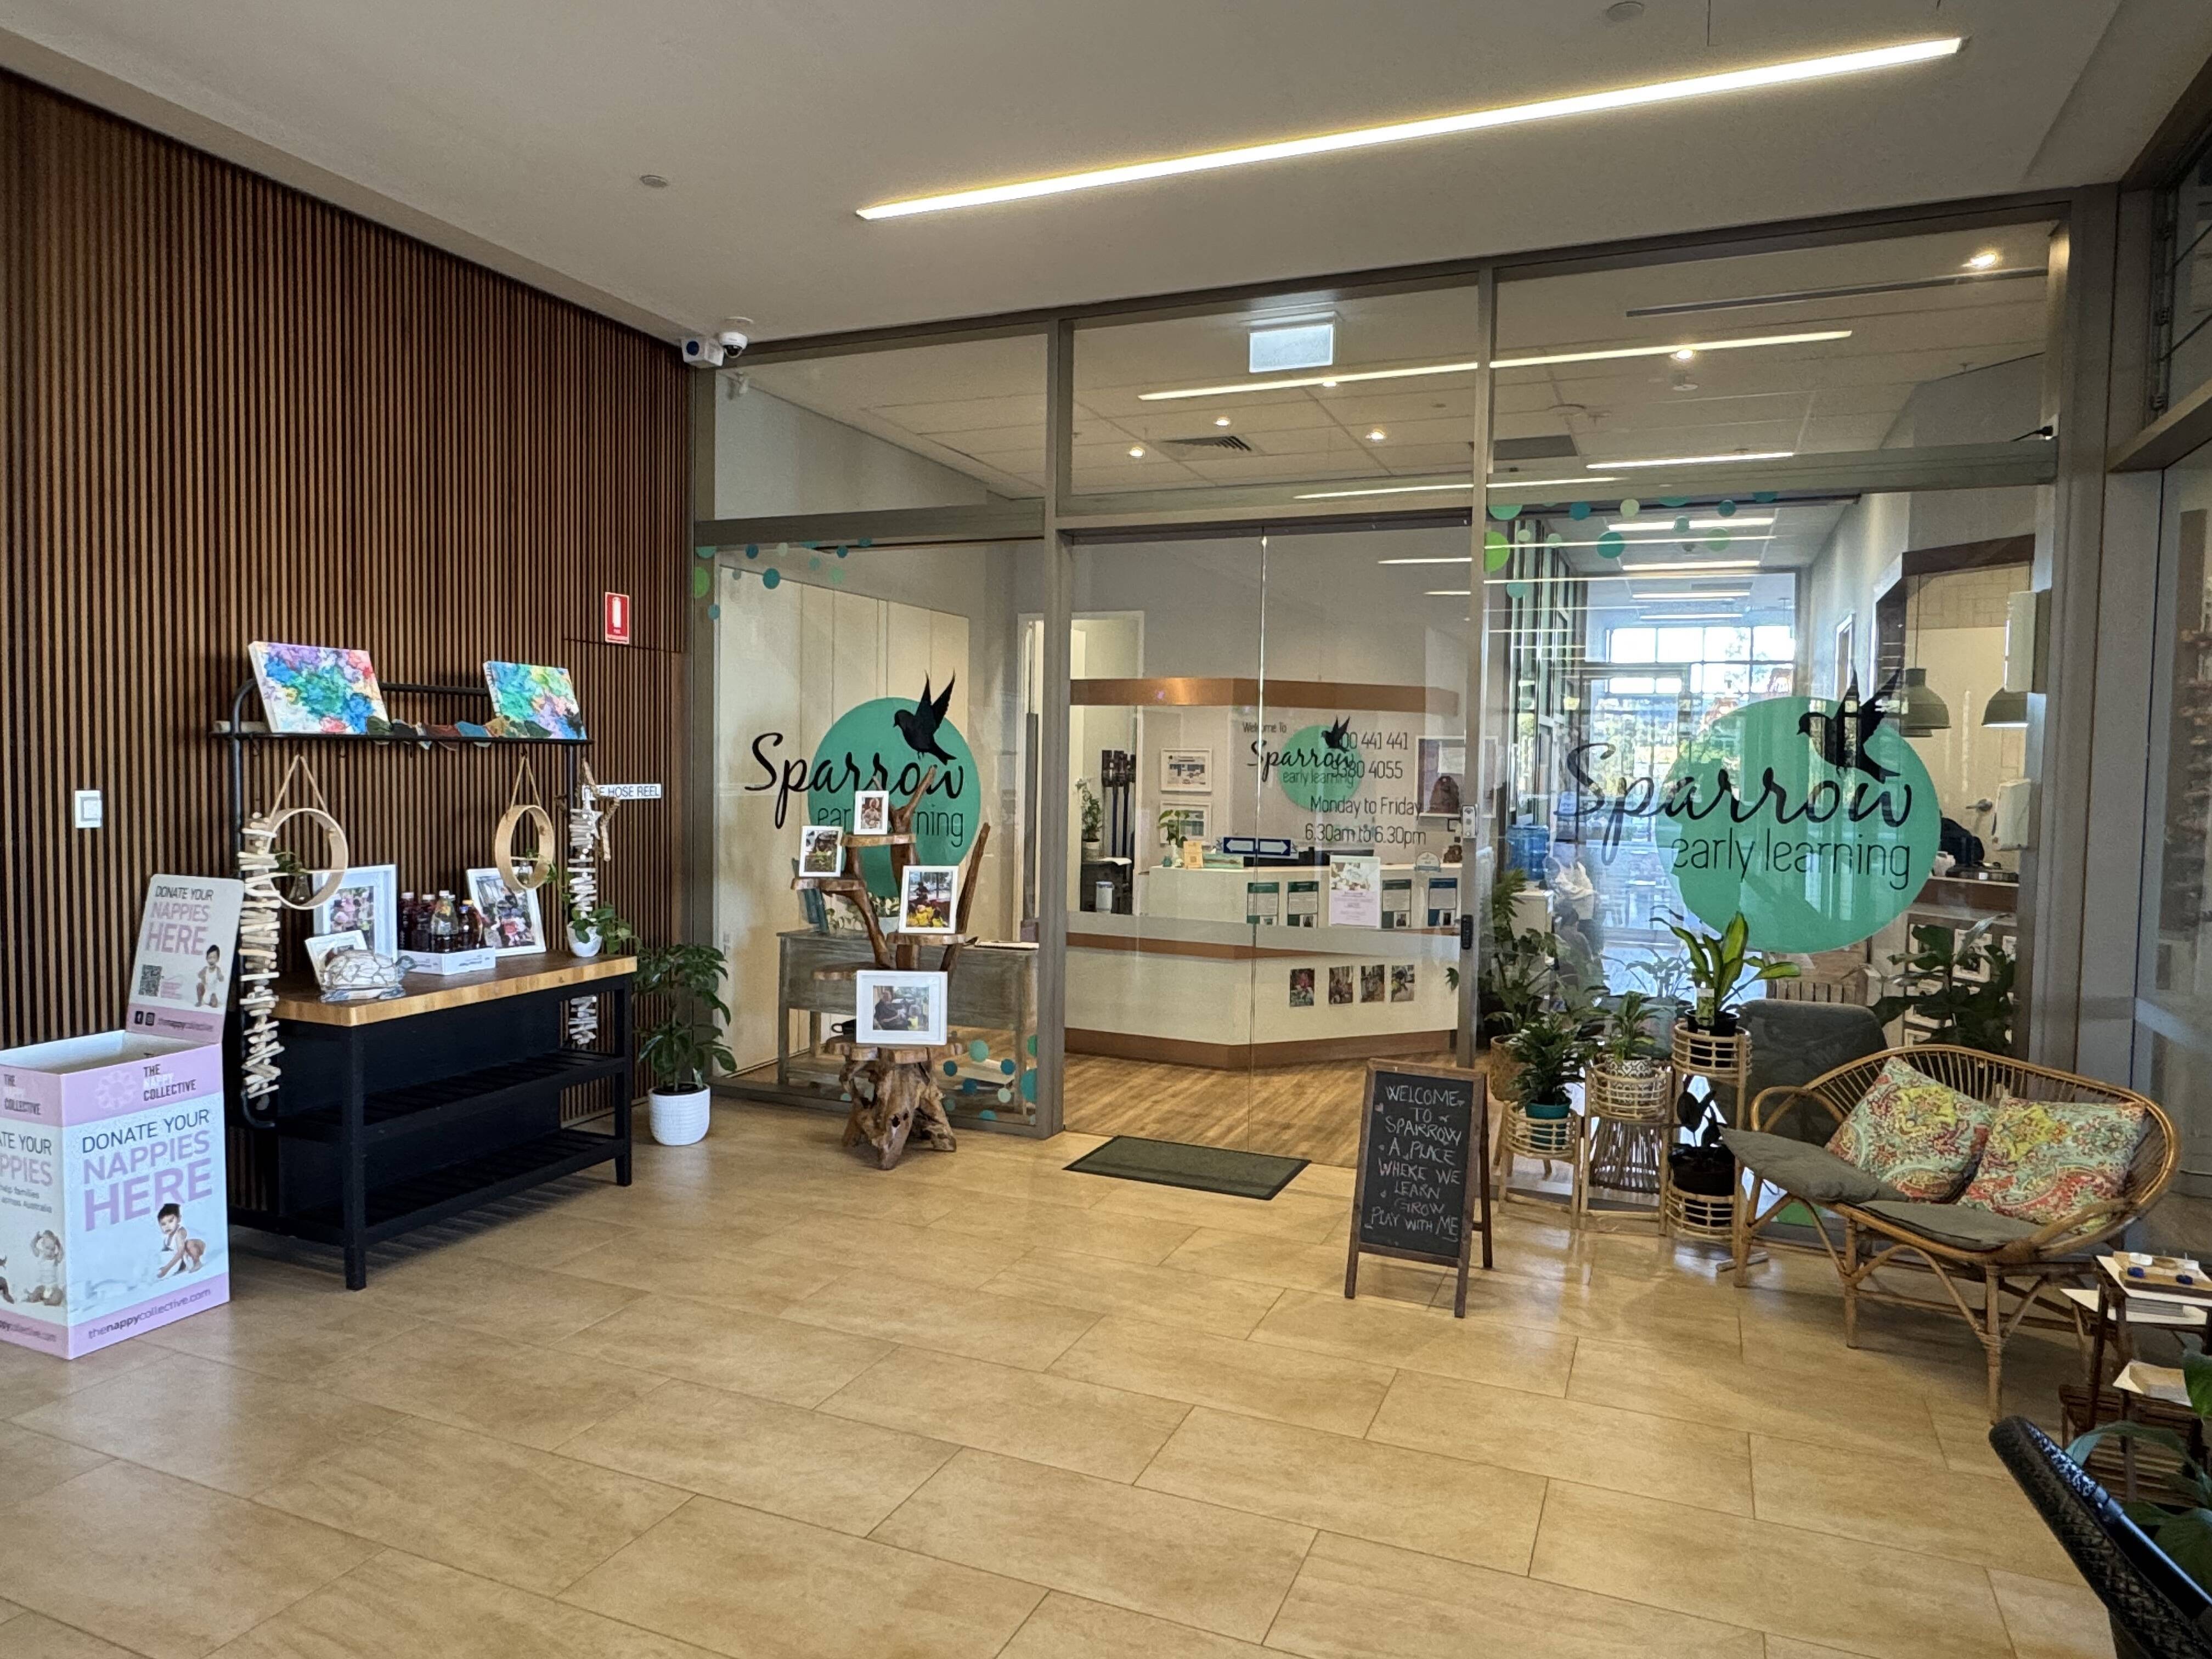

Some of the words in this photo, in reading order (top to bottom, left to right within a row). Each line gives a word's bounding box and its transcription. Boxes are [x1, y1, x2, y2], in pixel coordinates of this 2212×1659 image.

[1279, 722, 1287, 733] To
[1361, 731, 1382, 750] 441
[1386, 731, 1408, 751] 441
[1247, 740, 1353, 782] Sparrow
[1369, 760, 1403, 779] 4055
[744, 732, 964, 830] Sparrow
[1283, 769, 1308, 787] early
[608, 786, 634, 798] HOSE
[637, 786, 660, 797] REEL
[1553, 742, 1913, 866] Sparrow
[1310, 795, 1361, 819] Monday
[1364, 798, 1377, 815] to
[1380, 797, 1422, 821] Friday
[1305, 823, 1356, 842] 6.30am
[1358, 825, 1372, 843] to
[1374, 825, 1426, 849] 6.30pm
[1672, 827, 1755, 884] early
[1765, 828, 1910, 890] learning
[155, 885, 189, 900] DONATE
[190, 887, 214, 901] YOUR
[151, 901, 211, 923] NAPPIES
[145, 921, 208, 956] HERE
[143, 1064, 161, 1078] THE
[143, 1079, 196, 1102] COLLECTIVE
[1385, 1085, 1459, 1106] WELCOME
[1409, 1107, 1432, 1124] TO
[82, 1121, 159, 1154] DONATE
[163, 1109, 210, 1133] YOUR
[1385, 1115, 1462, 1147] SPARROW
[18, 1133, 52, 1156] YOUR
[83, 1130, 210, 1185] NAPPIES
[1388, 1137, 1401, 1156] A
[1410, 1141, 1456, 1166] PLACE
[1378, 1157, 1428, 1181] WHERE
[1435, 1167, 1462, 1185] WE
[84, 1158, 213, 1232] HERE
[1394, 1180, 1441, 1200] LEARN
[1394, 1197, 1446, 1217] GROW
[1371, 1206, 1400, 1227] PLAY
[1404, 1217, 1434, 1233] WITH
[1435, 1215, 1459, 1236] ME
[88, 1288, 211, 1339] thenappycollective.com
